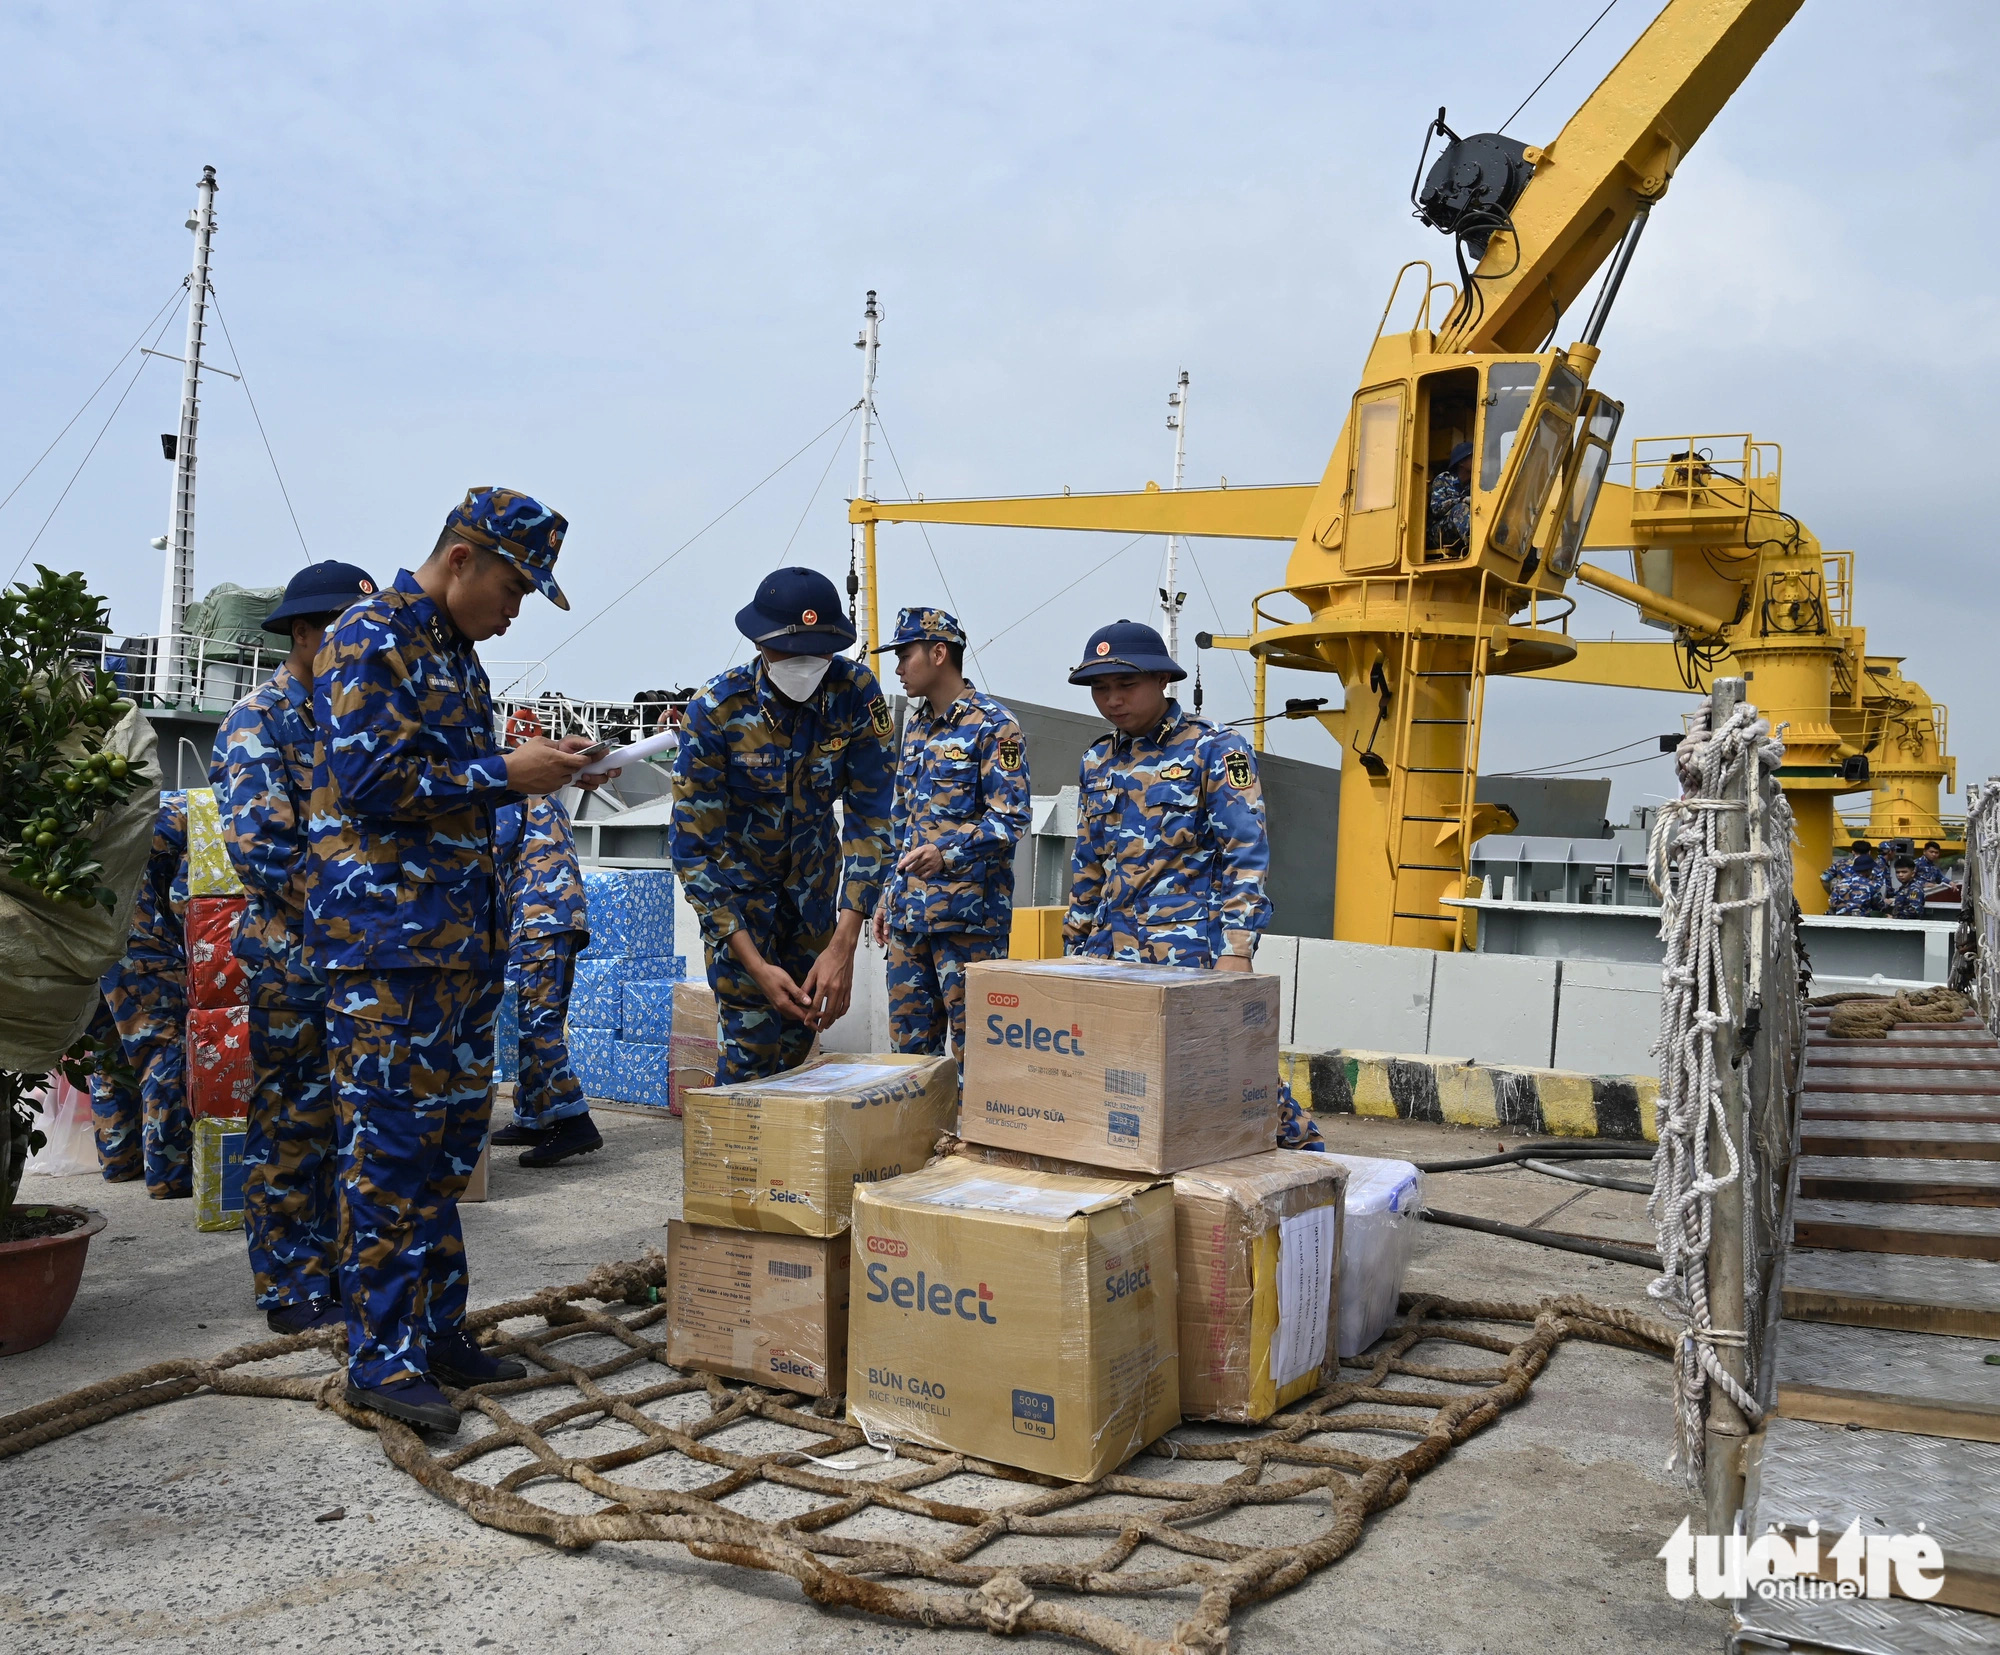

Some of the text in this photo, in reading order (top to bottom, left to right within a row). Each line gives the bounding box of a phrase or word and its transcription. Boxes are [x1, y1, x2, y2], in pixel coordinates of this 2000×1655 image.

[987, 993, 1019, 1007] COOP
[986, 1013, 1085, 1057] Select
[1242, 1085, 1268, 1103] Select
[986, 1100, 1066, 1124] BÁNH QUY SỮA
[985, 1117, 1028, 1131] MILK BISCUITS
[868, 1237, 908, 1257] COOP
[1208, 1224, 1229, 1255] VẬN
[1105, 1256, 1121, 1270] COOP
[866, 1262, 997, 1325] Select
[1106, 1262, 1152, 1303] Select
[770, 1357, 815, 1379] Select
[868, 1367, 946, 1401] BÚN GẠO
[868, 1389, 951, 1418] RICE VERMICELLI
[1019, 1395, 1048, 1412] 500 g
[1023, 1421, 1046, 1435] 10 kg
